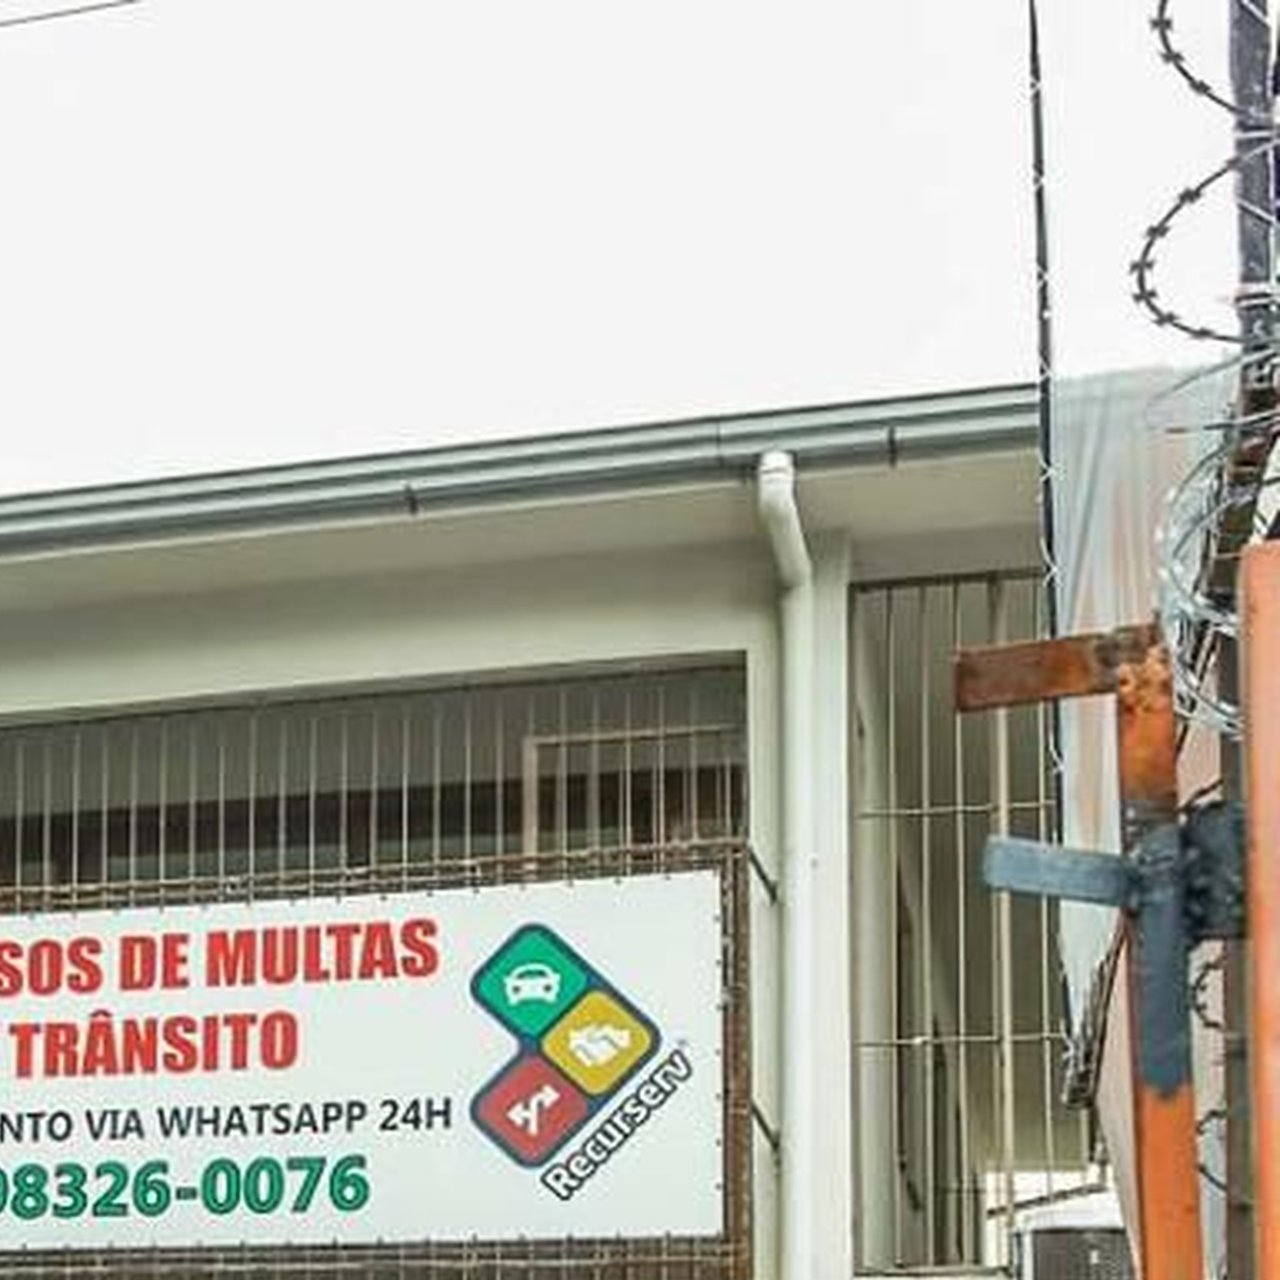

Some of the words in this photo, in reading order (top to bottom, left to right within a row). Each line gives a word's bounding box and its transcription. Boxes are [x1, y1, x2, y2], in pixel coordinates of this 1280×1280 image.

[119, 934, 189, 991] DE
[206, 919, 439, 986] MULTAS
[9, 1009, 299, 1077] TRÂNSITO
[86, 1109, 145, 1141] VIA
[157, 1101, 368, 1138] WHATSAPP
[379, 1098, 452, 1132] 24H
[540, 1050, 694, 1201] Recurserv
